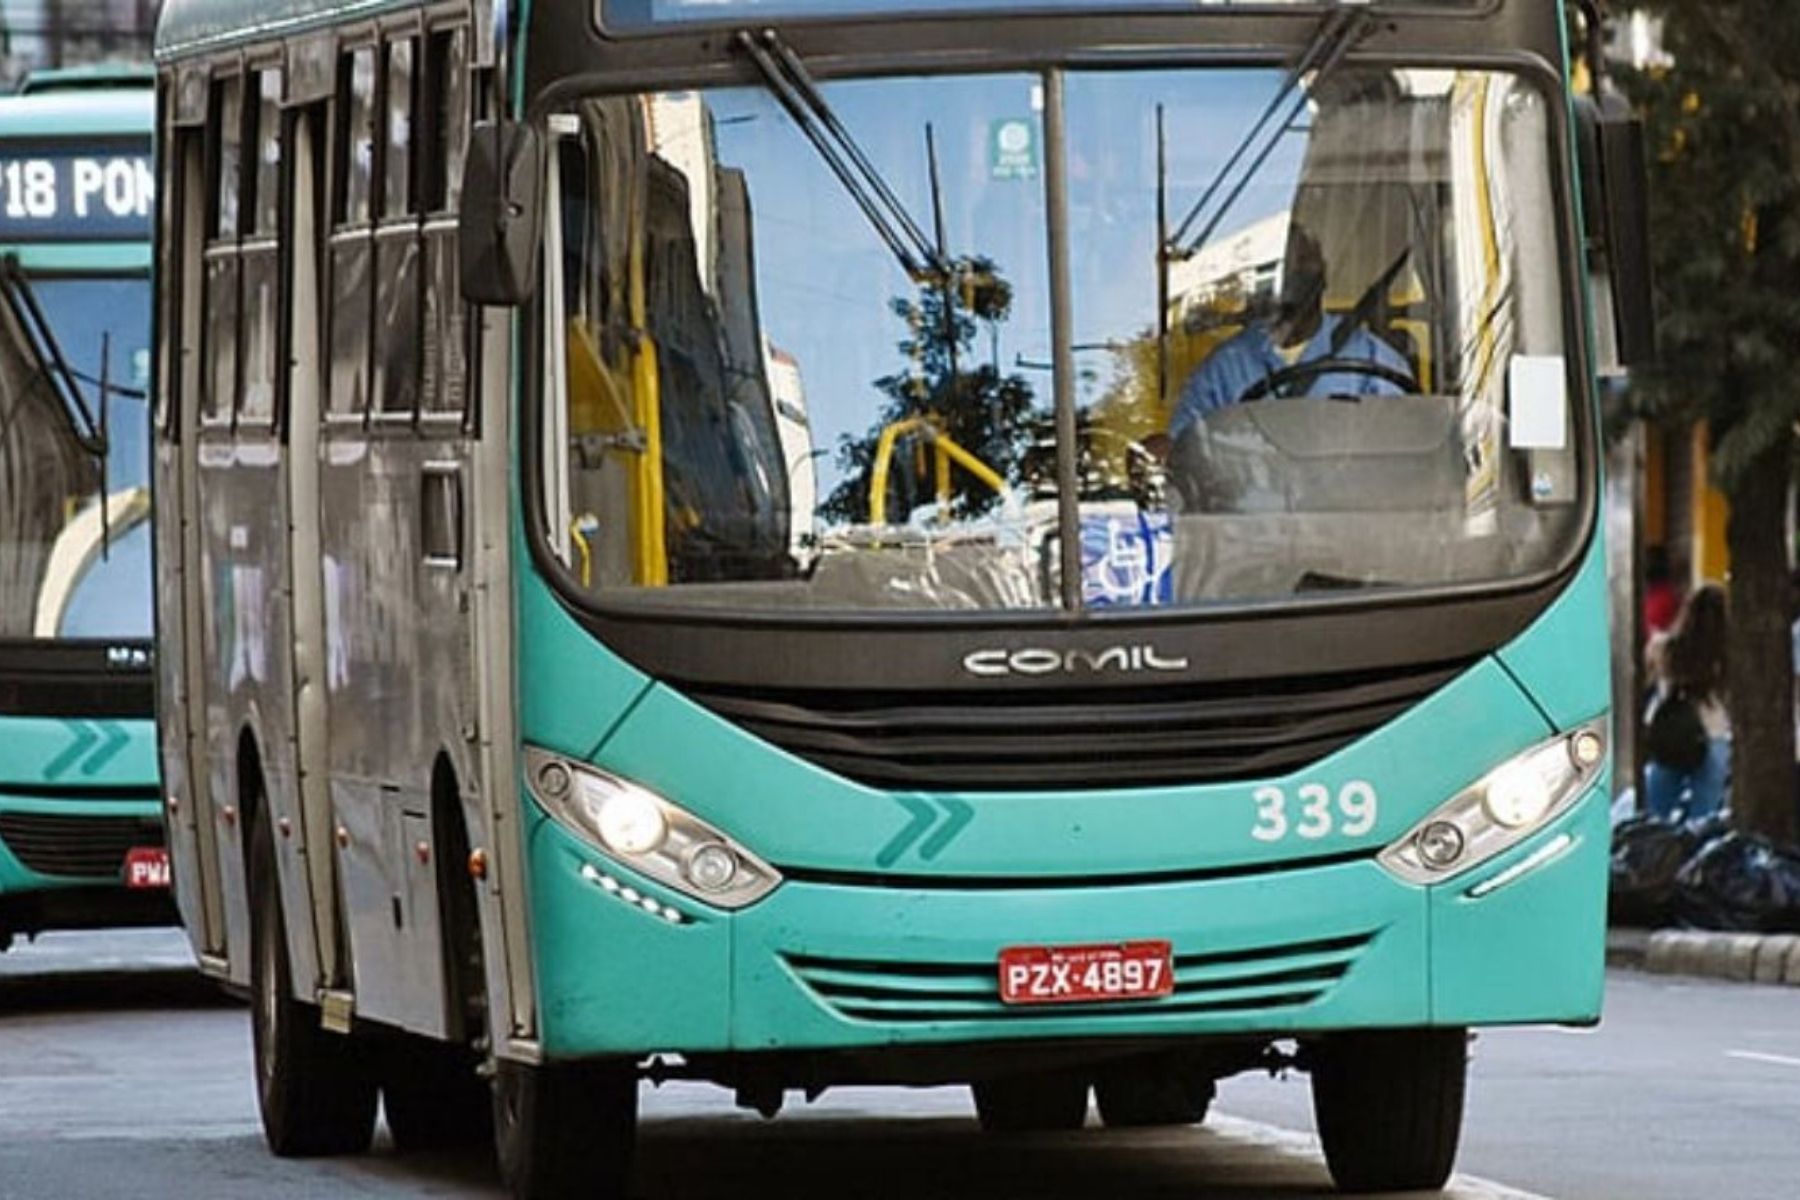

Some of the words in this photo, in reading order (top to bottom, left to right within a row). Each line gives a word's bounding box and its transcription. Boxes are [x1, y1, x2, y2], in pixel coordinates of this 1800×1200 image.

[0, 159, 57, 217] 18
[963, 645, 1188, 675] COMIL
[1250, 780, 1378, 841] 339
